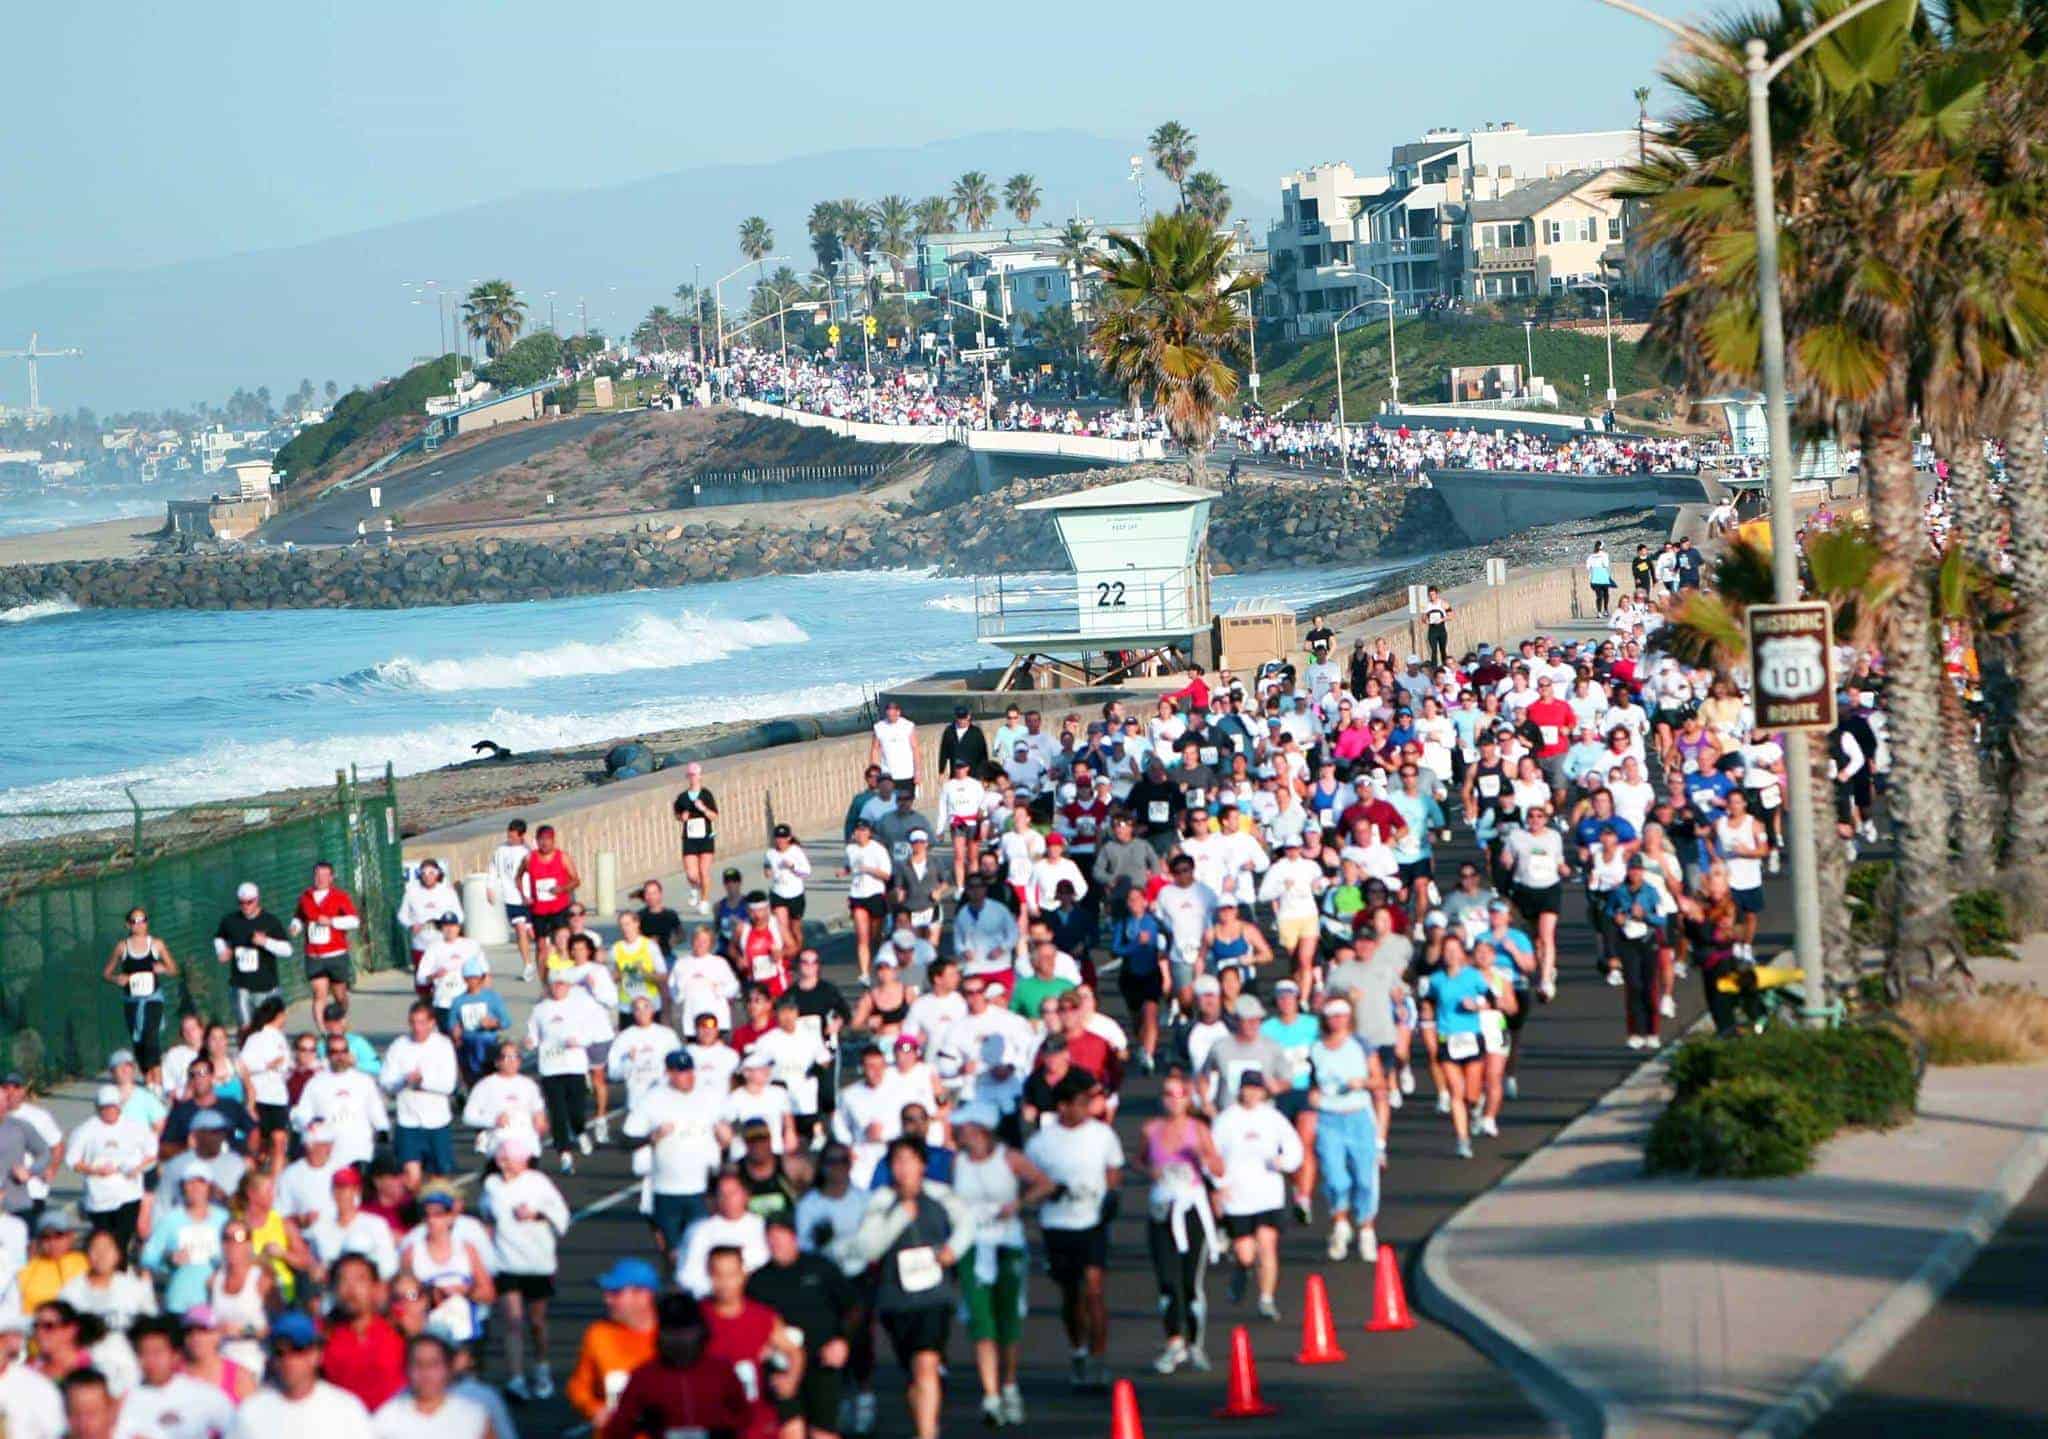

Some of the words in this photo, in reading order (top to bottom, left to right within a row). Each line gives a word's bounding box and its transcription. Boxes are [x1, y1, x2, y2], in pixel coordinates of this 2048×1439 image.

[1742, 435, 1755, 448] 24
[1097, 581, 1126, 606] 22
[1753, 612, 1824, 633] HISTORIC
[1772, 667, 1813, 688] 101
[1767, 702, 1820, 721] ROUTE
